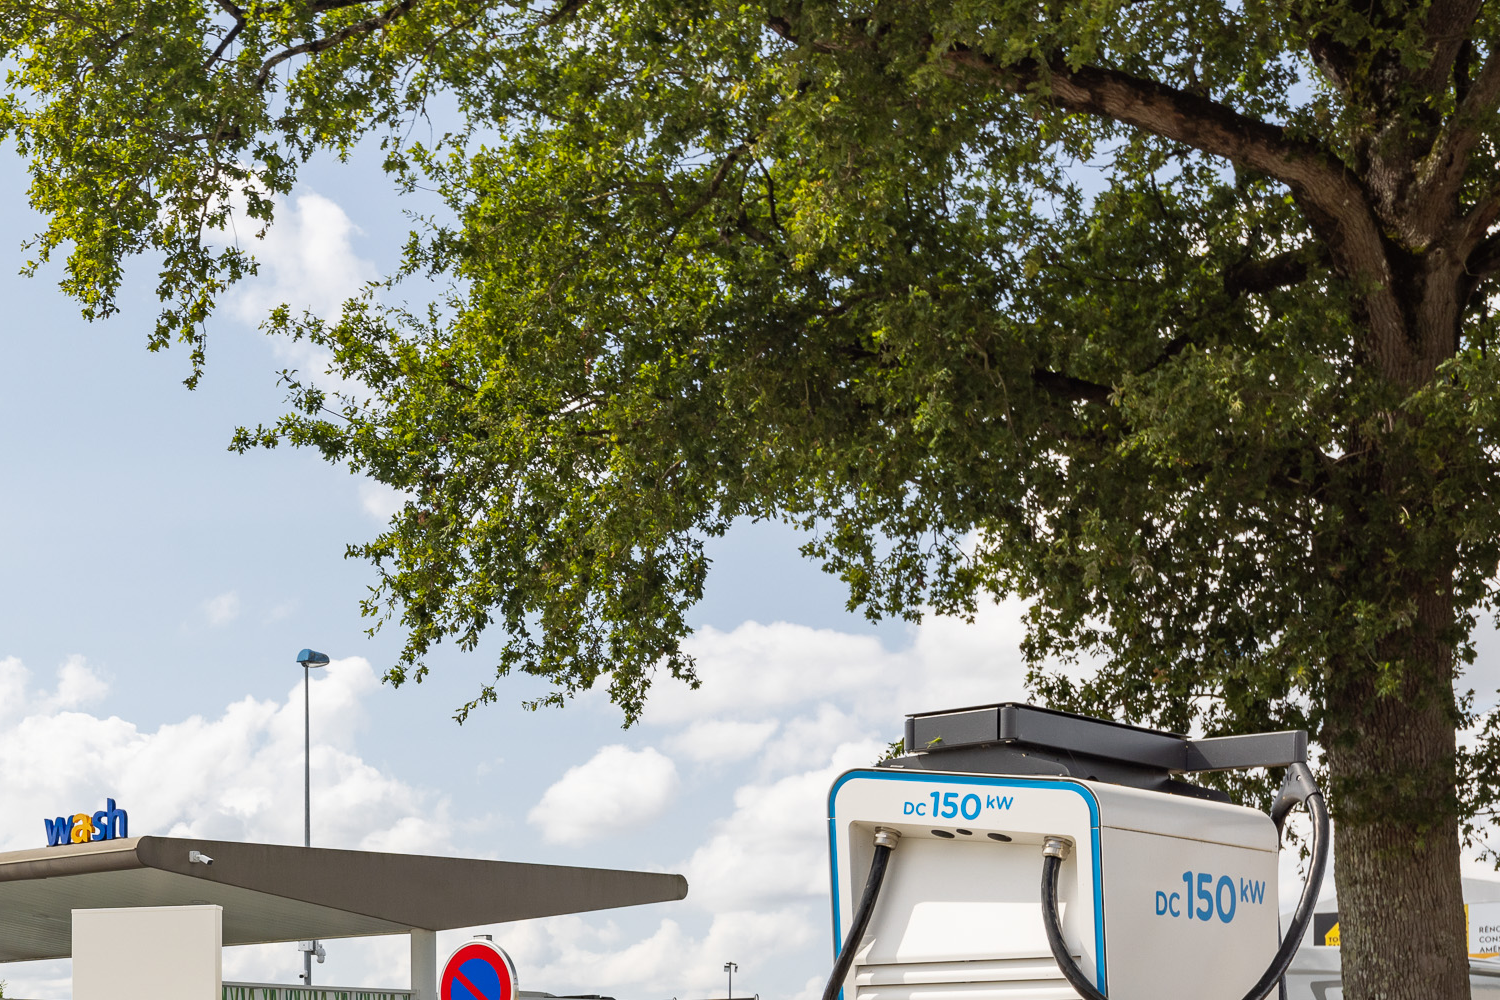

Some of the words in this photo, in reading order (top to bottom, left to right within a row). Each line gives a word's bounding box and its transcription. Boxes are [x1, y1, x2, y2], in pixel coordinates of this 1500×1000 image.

[44, 797, 128, 846] wash
[903, 801, 927, 817] DC
[929, 790, 982, 821] 150
[985, 795, 1014, 811] kW
[1155, 890, 1181, 918] DC
[1182, 870, 1237, 924] 150
[1240, 877, 1266, 905] kW
